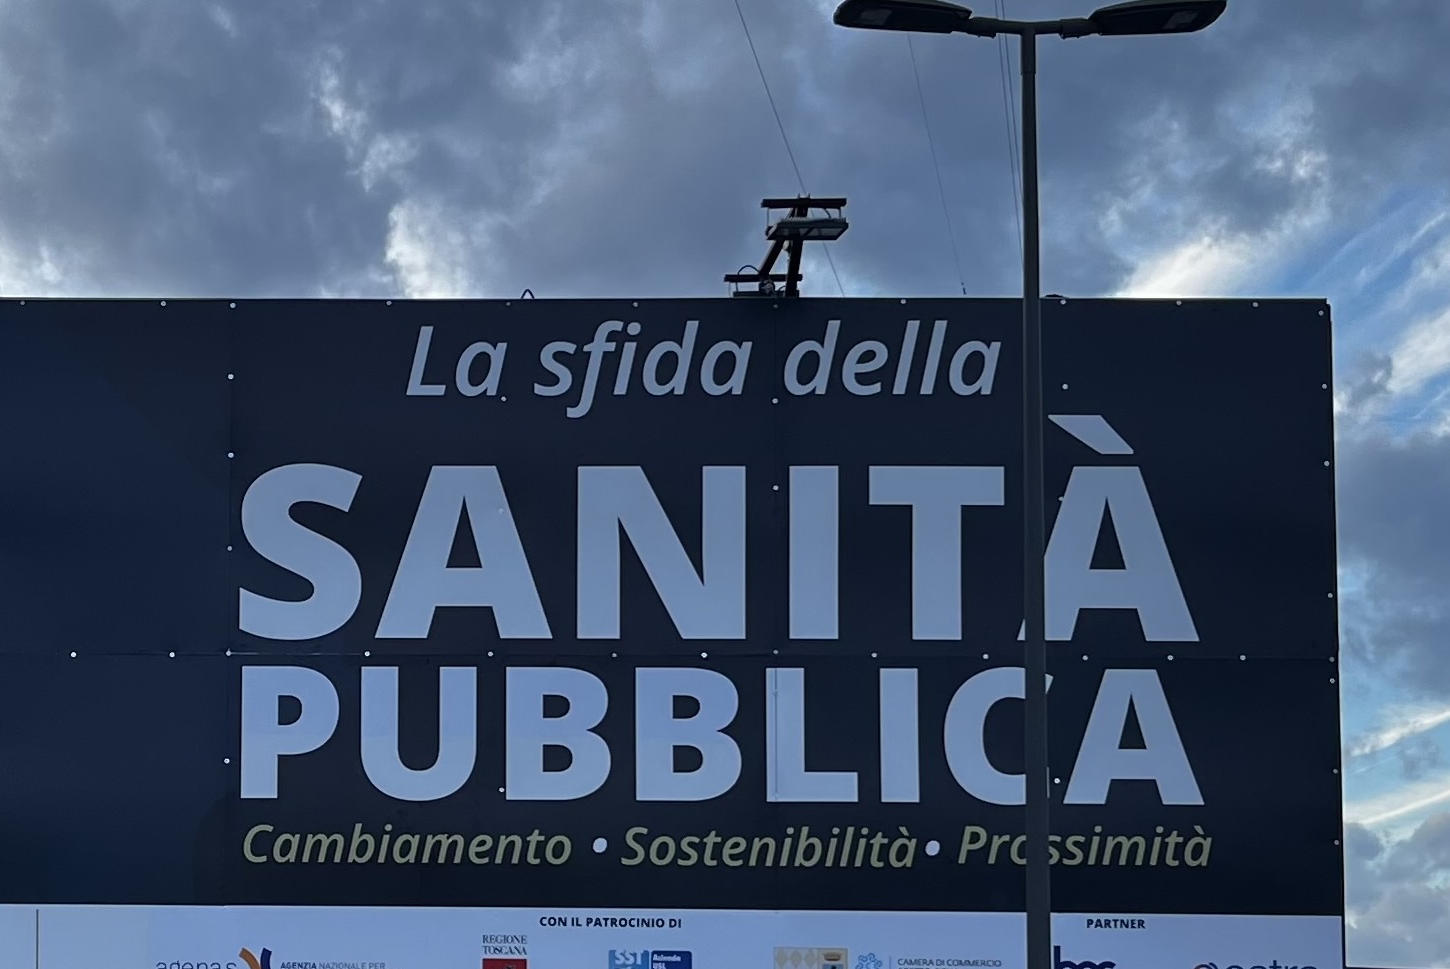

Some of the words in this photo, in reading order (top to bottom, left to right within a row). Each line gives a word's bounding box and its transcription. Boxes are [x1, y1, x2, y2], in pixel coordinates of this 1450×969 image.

[406, 326, 507, 396] La
[534, 321, 752, 418] sfida
[784, 320, 1001, 395] della
[240, 414, 1200, 642] SANITÀ
[240, 665, 1204, 806] PUBBLICA
[244, 823, 571, 864] Cambiamento
[621, 827, 916, 867] Sostenibilità
[958, 825, 1212, 867] Prossimità
[540, 916, 567, 926] CON
[571, 917, 582, 926] IL
[586, 917, 664, 927] PATROCINIO
[669, 918, 682, 928] DI
[1086, 919, 1146, 929] PARTNER
[482, 935, 527, 944] REGIONE
[482, 946, 527, 955] TOSCANA
[319, 962, 367, 969] NAZIONALE
[897, 958, 934, 966] CAMERA
[947, 959, 1002, 967] COMMERCIO
